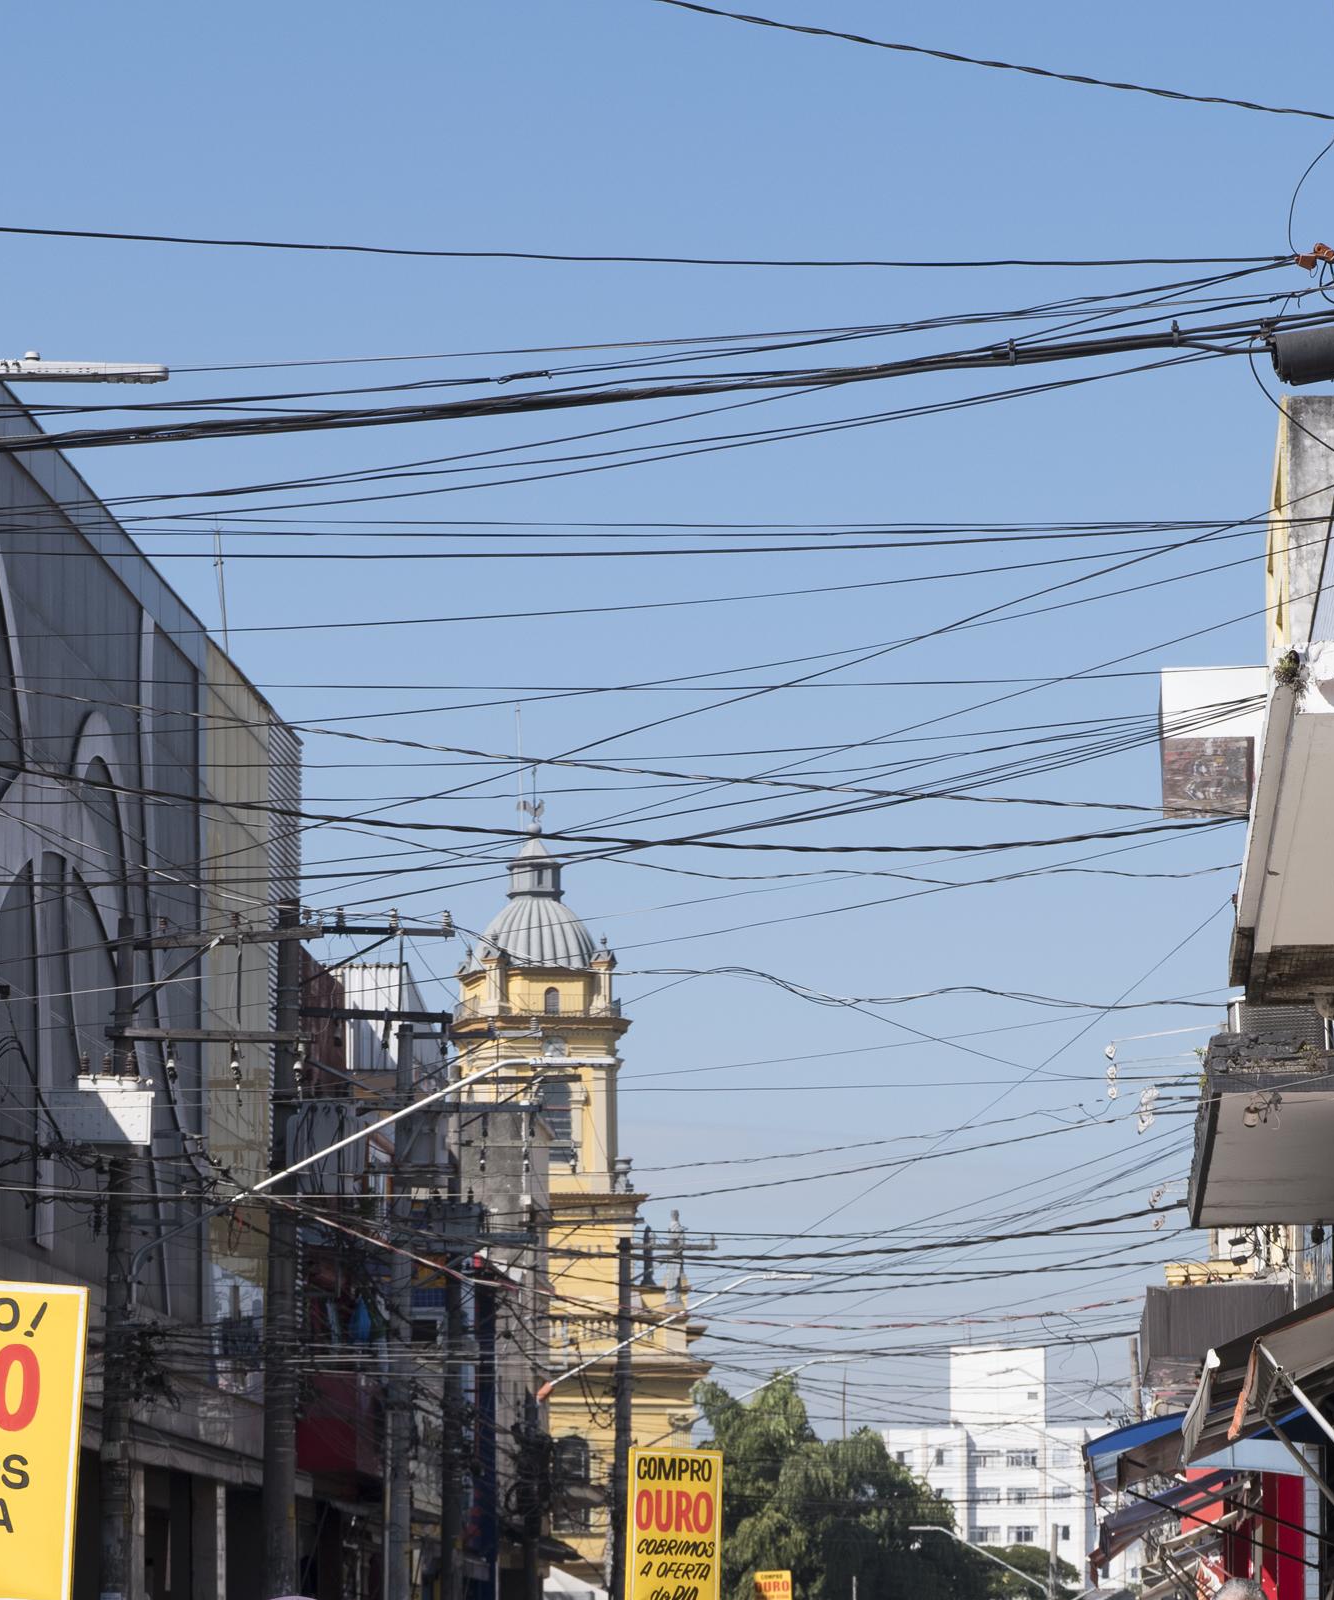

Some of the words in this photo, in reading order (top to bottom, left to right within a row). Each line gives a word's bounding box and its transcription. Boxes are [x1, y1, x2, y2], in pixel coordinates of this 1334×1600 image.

[637, 1457, 712, 1482] COMPRO
[636, 1489, 713, 1534] OURO
[637, 1539, 715, 1558] COBRIMOS
[640, 1561, 653, 1577] A
[656, 1561, 711, 1581] OFERTA
